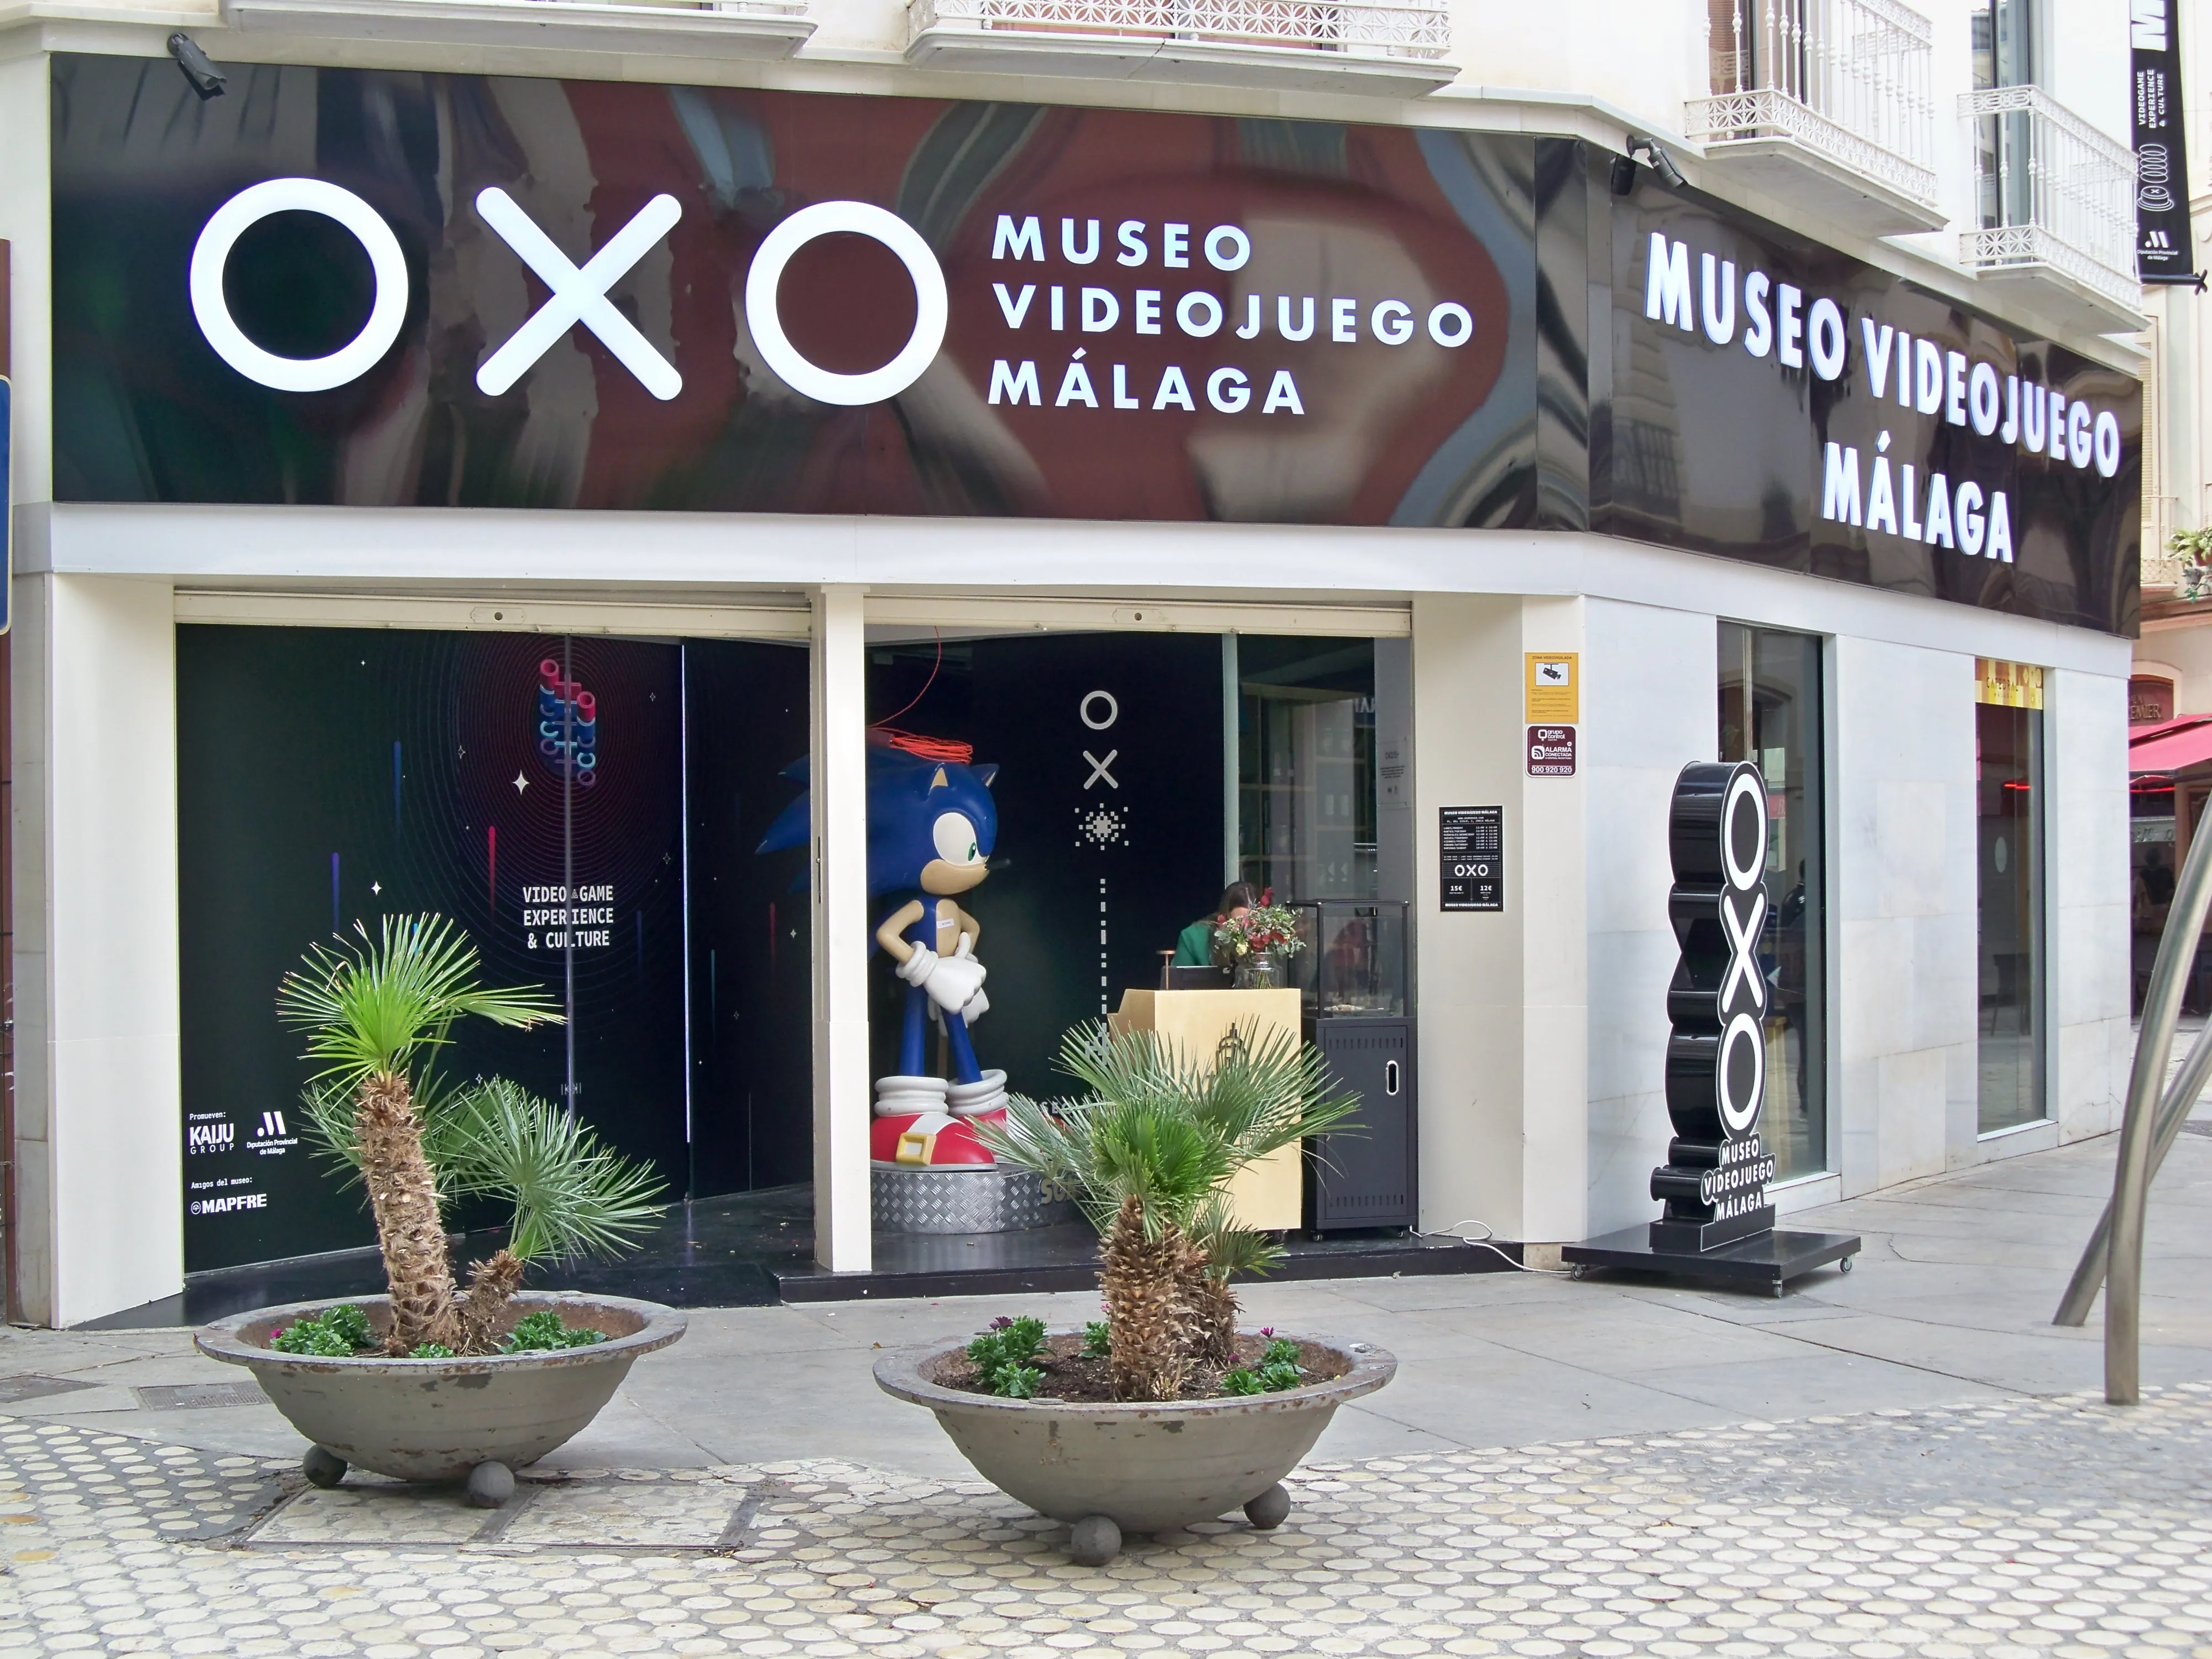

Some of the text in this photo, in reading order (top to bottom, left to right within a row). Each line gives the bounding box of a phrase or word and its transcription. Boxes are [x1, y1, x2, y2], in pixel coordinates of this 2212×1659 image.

[2137, 71, 2146, 126] VIDEOGAME
[2147, 69, 2156, 128] EXPERIENCE
[991, 215, 1250, 271] MUSEO
[190, 178, 948, 405] OXO
[992, 283, 1473, 347] VIDEOJUEGO
[1645, 232, 2120, 478] MUSEO VIDEOJUEGO
[988, 347, 1305, 415] MÁLAGA
[1820, 430, 2013, 563] MÁLAGA
[1986, 677, 2018, 692] CATEDRAL
[1454, 864, 1488, 877] OXO
[523, 885, 613, 902] VIDEO GAME
[524, 908, 613, 926] EXPERIENCE
[528, 930, 609, 949] & CULTURE
[1720, 773, 1765, 1130] OXO
[190, 1112, 226, 1120] Promueven:
[189, 1123, 234, 1146] KAIJU
[247, 1138, 298, 1149] Diputación Provincial
[190, 1143, 234, 1155] GROUP
[1721, 1139, 1759, 1165] MUSEO
[191, 1181, 213, 1189] Amigos
[217, 1178, 228, 1187] del
[1704, 1160, 1773, 1195] VIDEOJUEGO
[202, 1193, 267, 1214] MAPFRE
[1716, 1192, 1762, 1222] MÁLAGA
